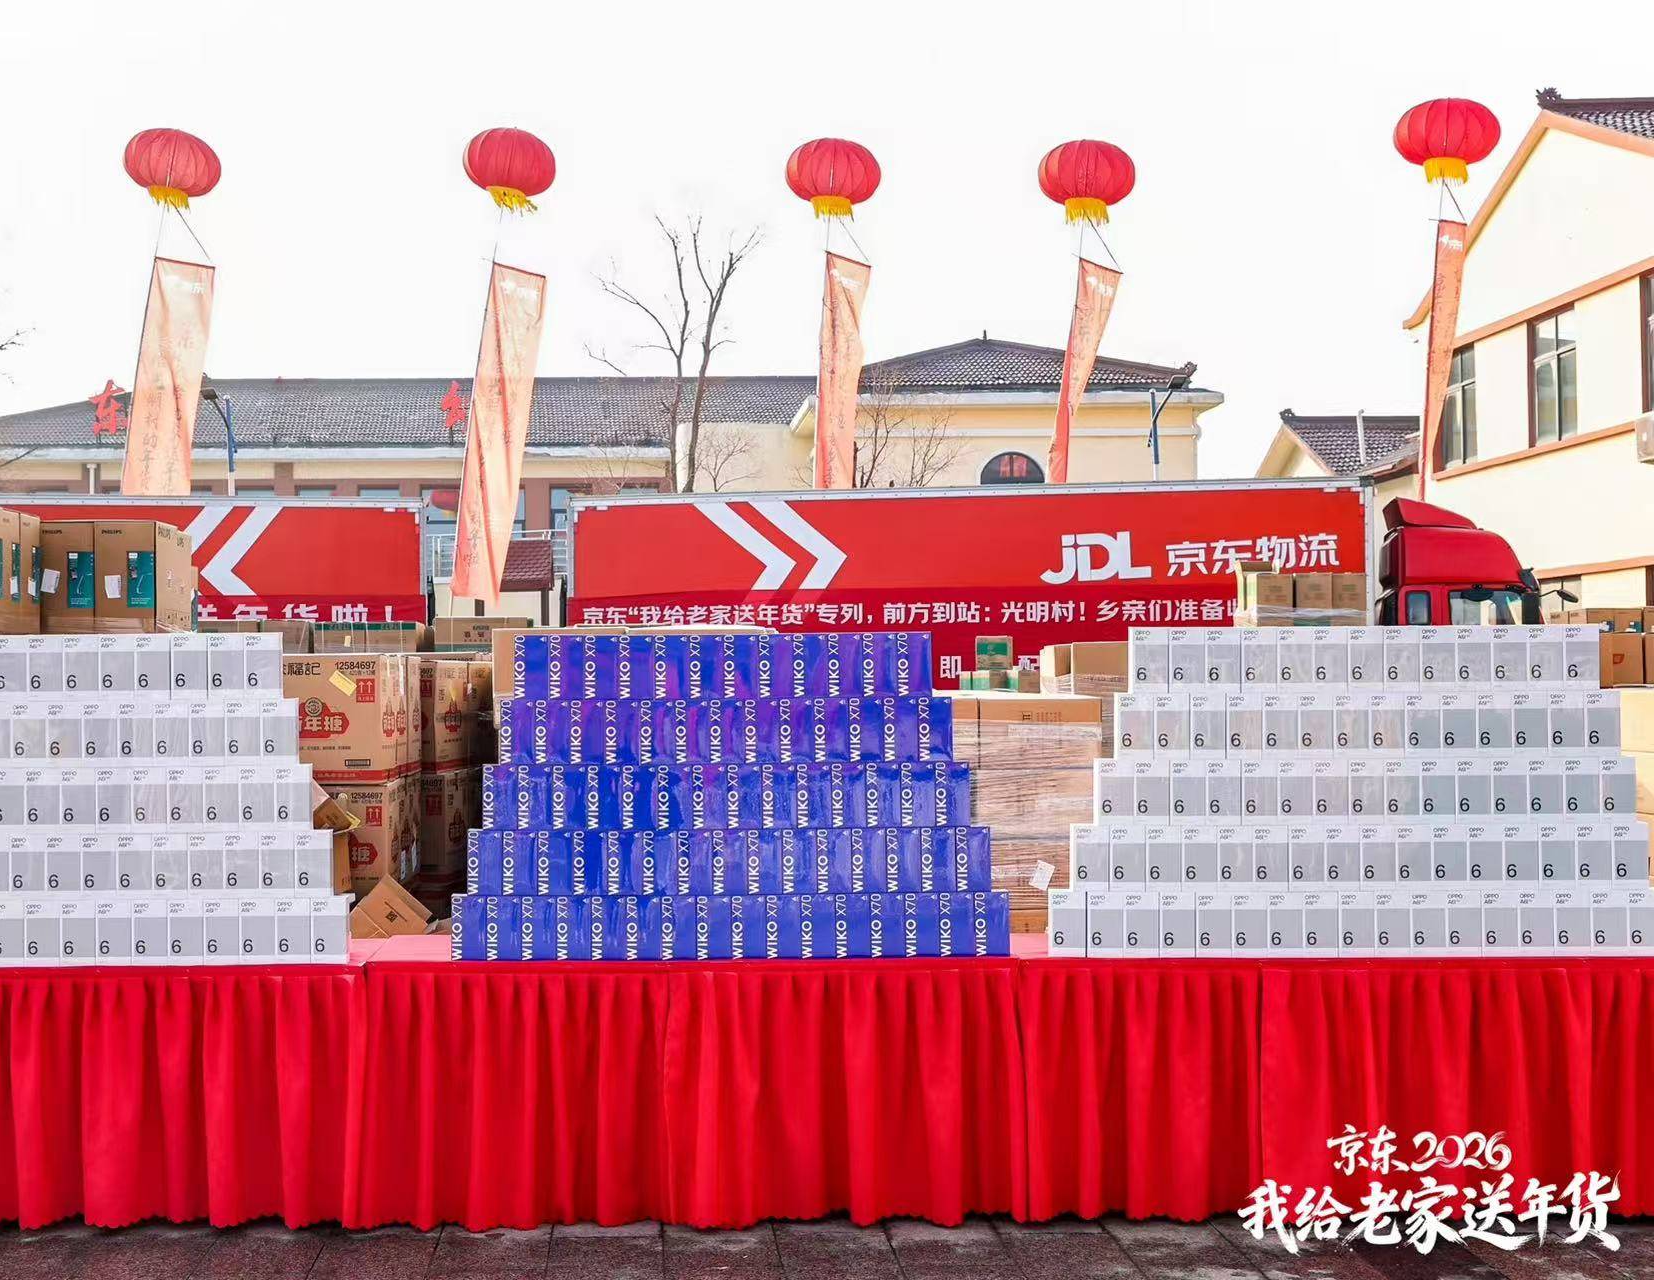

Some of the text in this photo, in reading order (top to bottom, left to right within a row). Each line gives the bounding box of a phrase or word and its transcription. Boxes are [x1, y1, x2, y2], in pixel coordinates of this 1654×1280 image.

[1039, 531, 1340, 585] JDL 京东物流
[247, 672, 258, 687] 6
[334, 661, 376, 671] 12584697
[514, 635, 525, 698] WIKO X70
[585, 635, 596, 698] WIKO X70
[690, 634, 701, 697] WIKO X70
[793, 634, 804, 697] WIKO X70
[897, 633, 908, 696] WIKO X70
[1173, 666, 1184, 681] 6
[1567, 663, 1579, 678] 6
[350, 791, 383, 800] 12584697
[538, 831, 549, 894] WIKO X70
[608, 831, 619, 894] WIKO X70
[679, 831, 690, 894] WIKO X70
[314, 938, 325, 953] 6
[522, 896, 533, 959] WIKO X70
[662, 896, 673, 959] WIKO X70
[767, 895, 778, 958] WIKO X70
[975, 893, 986, 956] WIKO X70
[1091, 931, 1102, 946] 6
